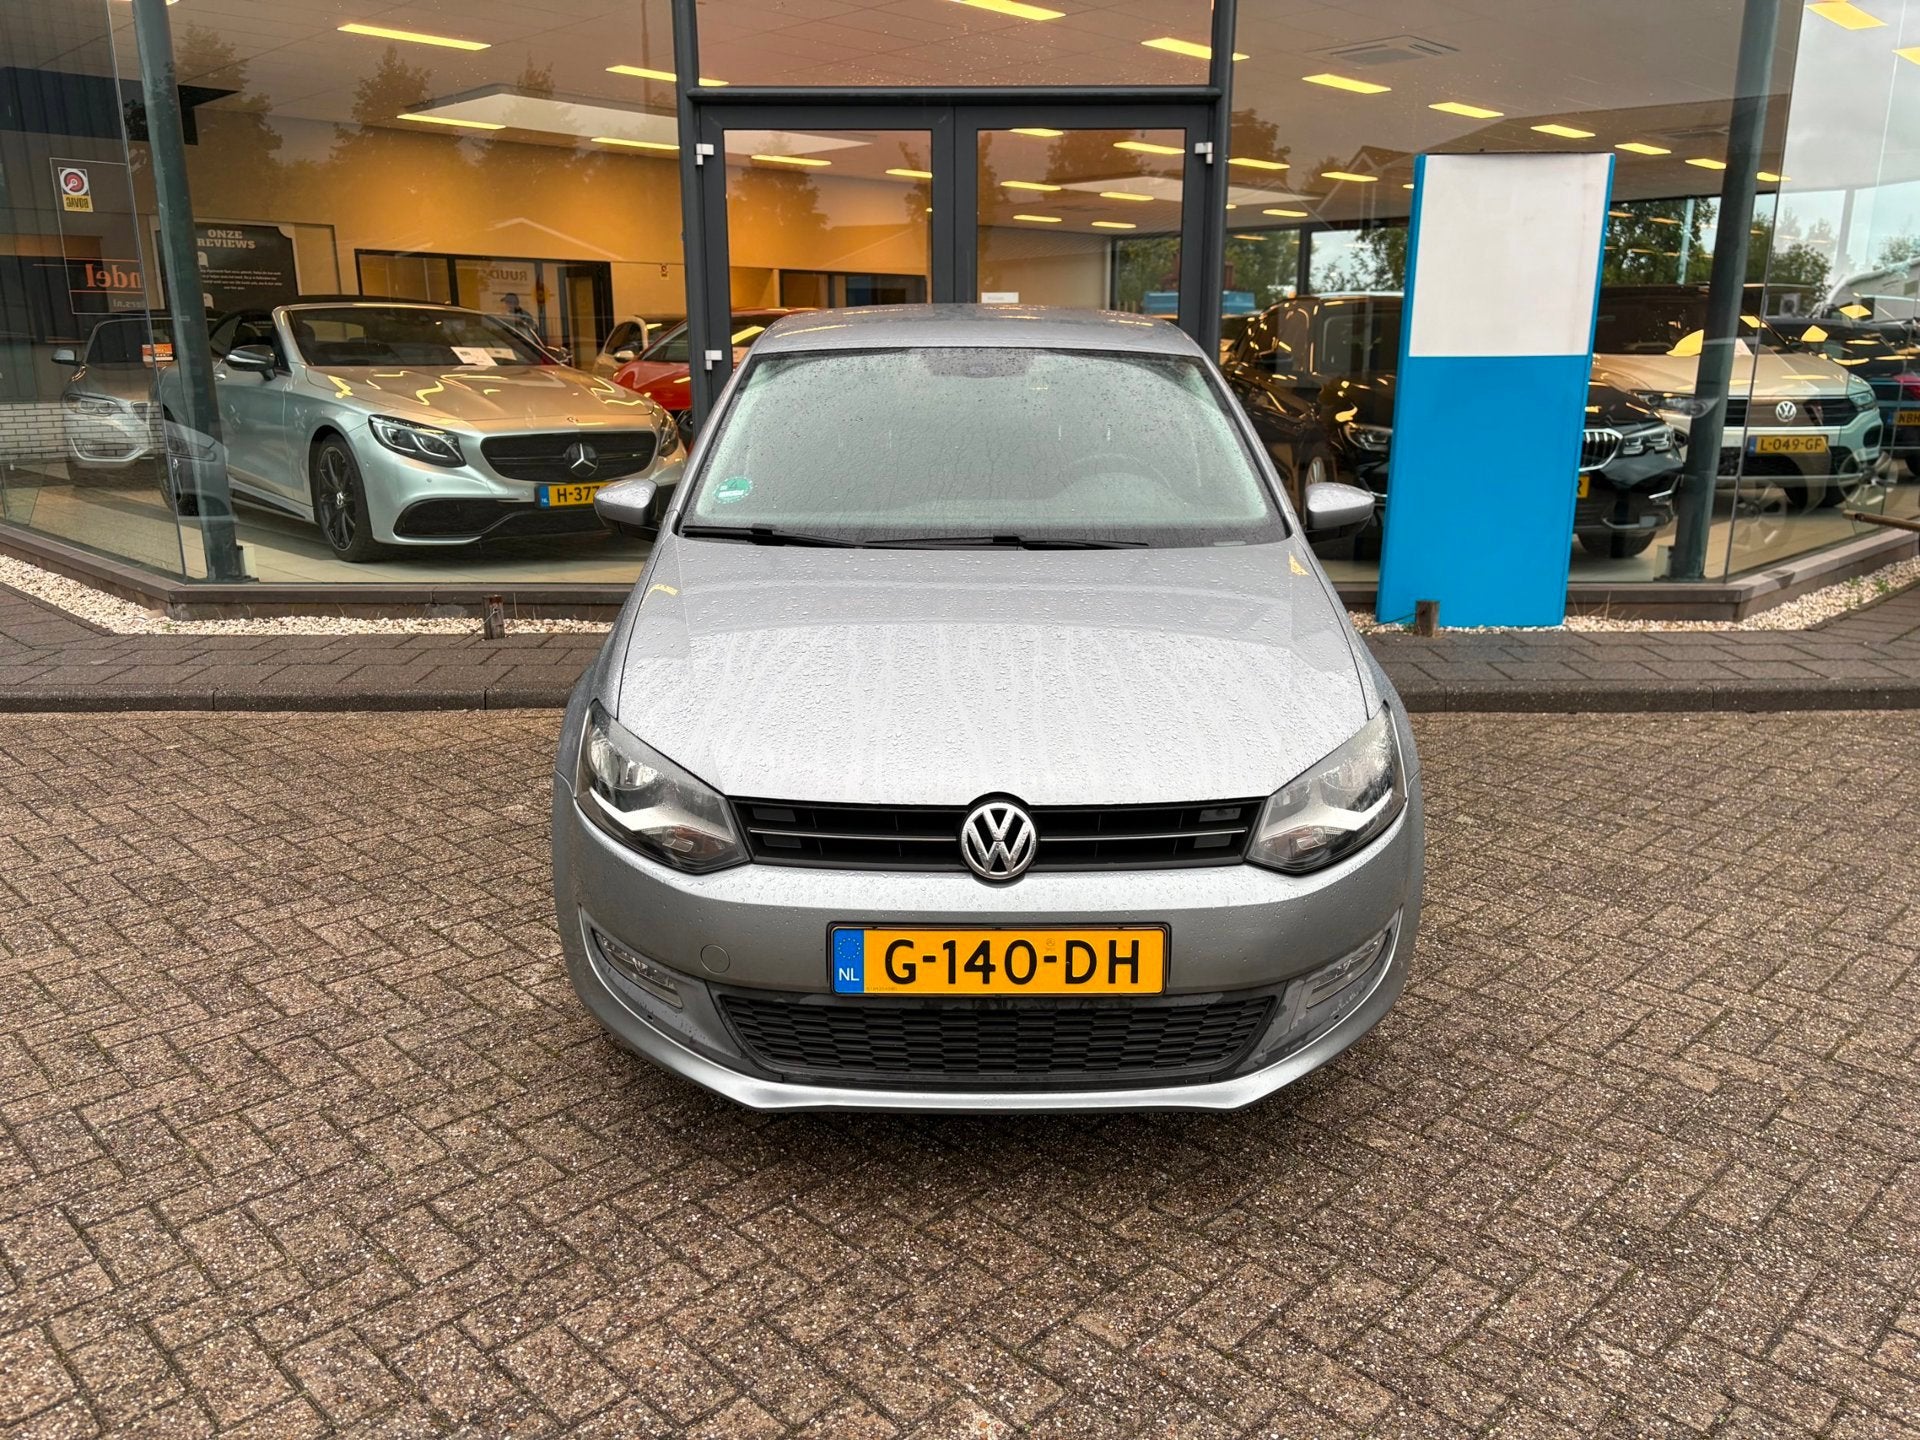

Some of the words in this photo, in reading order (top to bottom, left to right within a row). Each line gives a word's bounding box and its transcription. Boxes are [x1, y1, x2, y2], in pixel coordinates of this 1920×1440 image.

[207, 229, 243, 239] ONZE
[197, 238, 256, 249] REVIEWS
[1760, 438, 1823, 451] L-049-GF
[885, 939, 1140, 985] G-140-DH
[838, 967, 860, 981] NL
